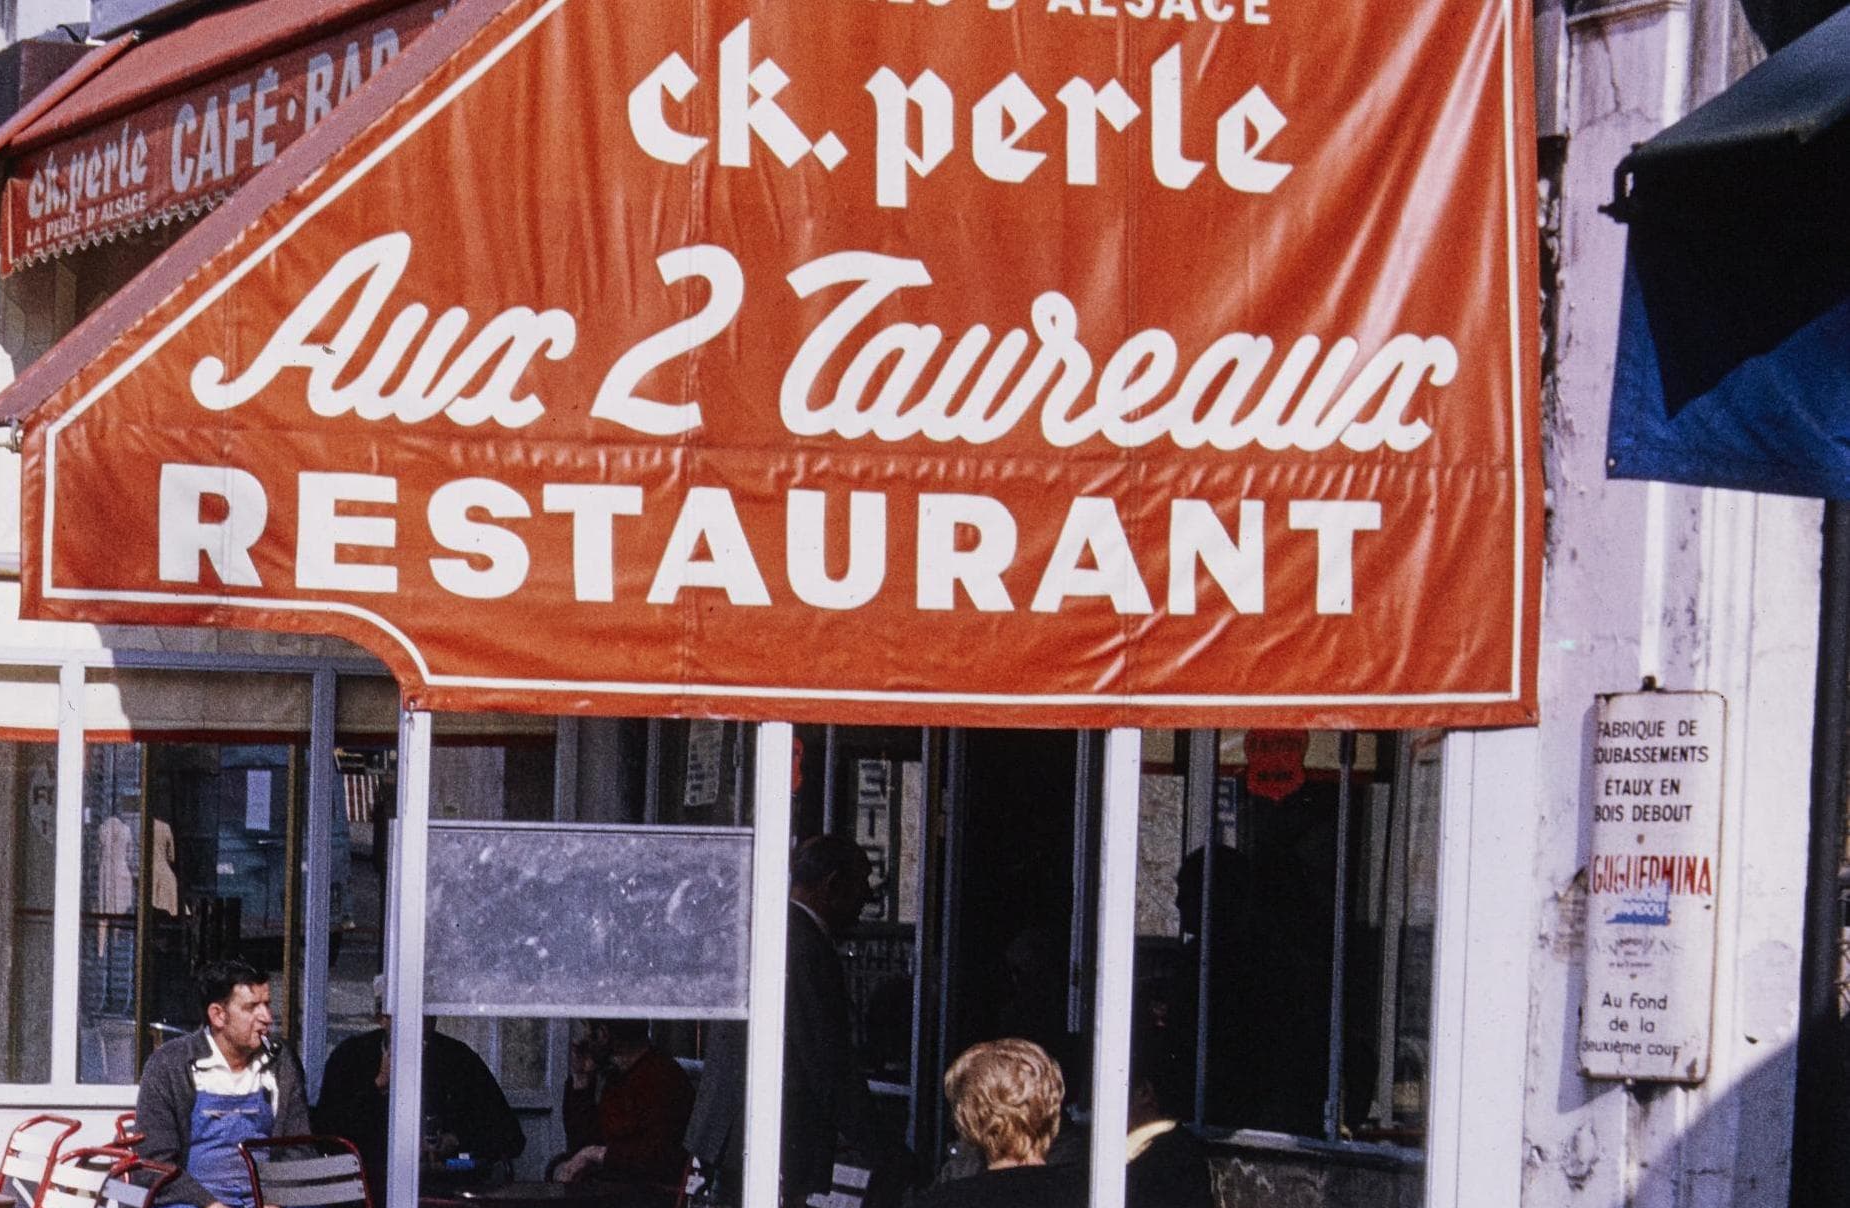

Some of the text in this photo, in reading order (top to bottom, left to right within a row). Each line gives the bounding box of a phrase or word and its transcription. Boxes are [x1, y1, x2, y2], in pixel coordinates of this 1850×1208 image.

[26, 226, 42, 248] LA
[45, 209, 83, 242] PERLE
[191, 231, 1457, 453] Aux 2 Taureaux
[158, 463, 1382, 616] RESTAURANT
[1597, 719, 1699, 740] FABRIQUE DE
[1660, 779, 1681, 796] EN
[1593, 804, 1693, 823] BOIS DEBOUT
[1602, 991, 1623, 1008] Au
[1608, 1016, 1656, 1033] de la
[1647, 1043, 1681, 1057] cour
